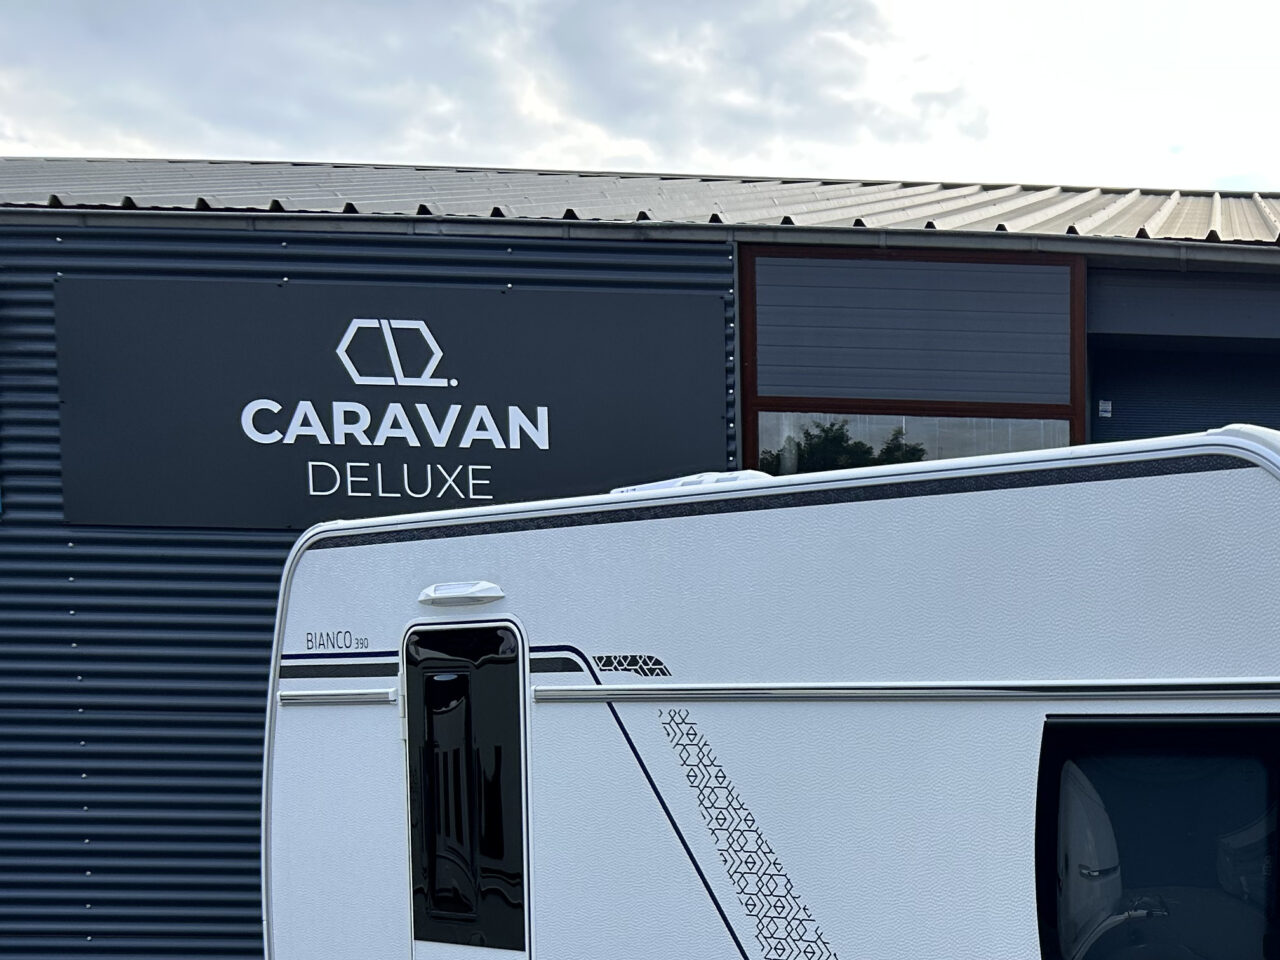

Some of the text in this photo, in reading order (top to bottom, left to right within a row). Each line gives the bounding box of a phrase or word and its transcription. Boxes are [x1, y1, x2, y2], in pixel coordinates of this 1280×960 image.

[241, 398, 549, 449] CARAVAN
[307, 461, 493, 499] DELUXE
[306, 630, 369, 650] BIANCO 390
